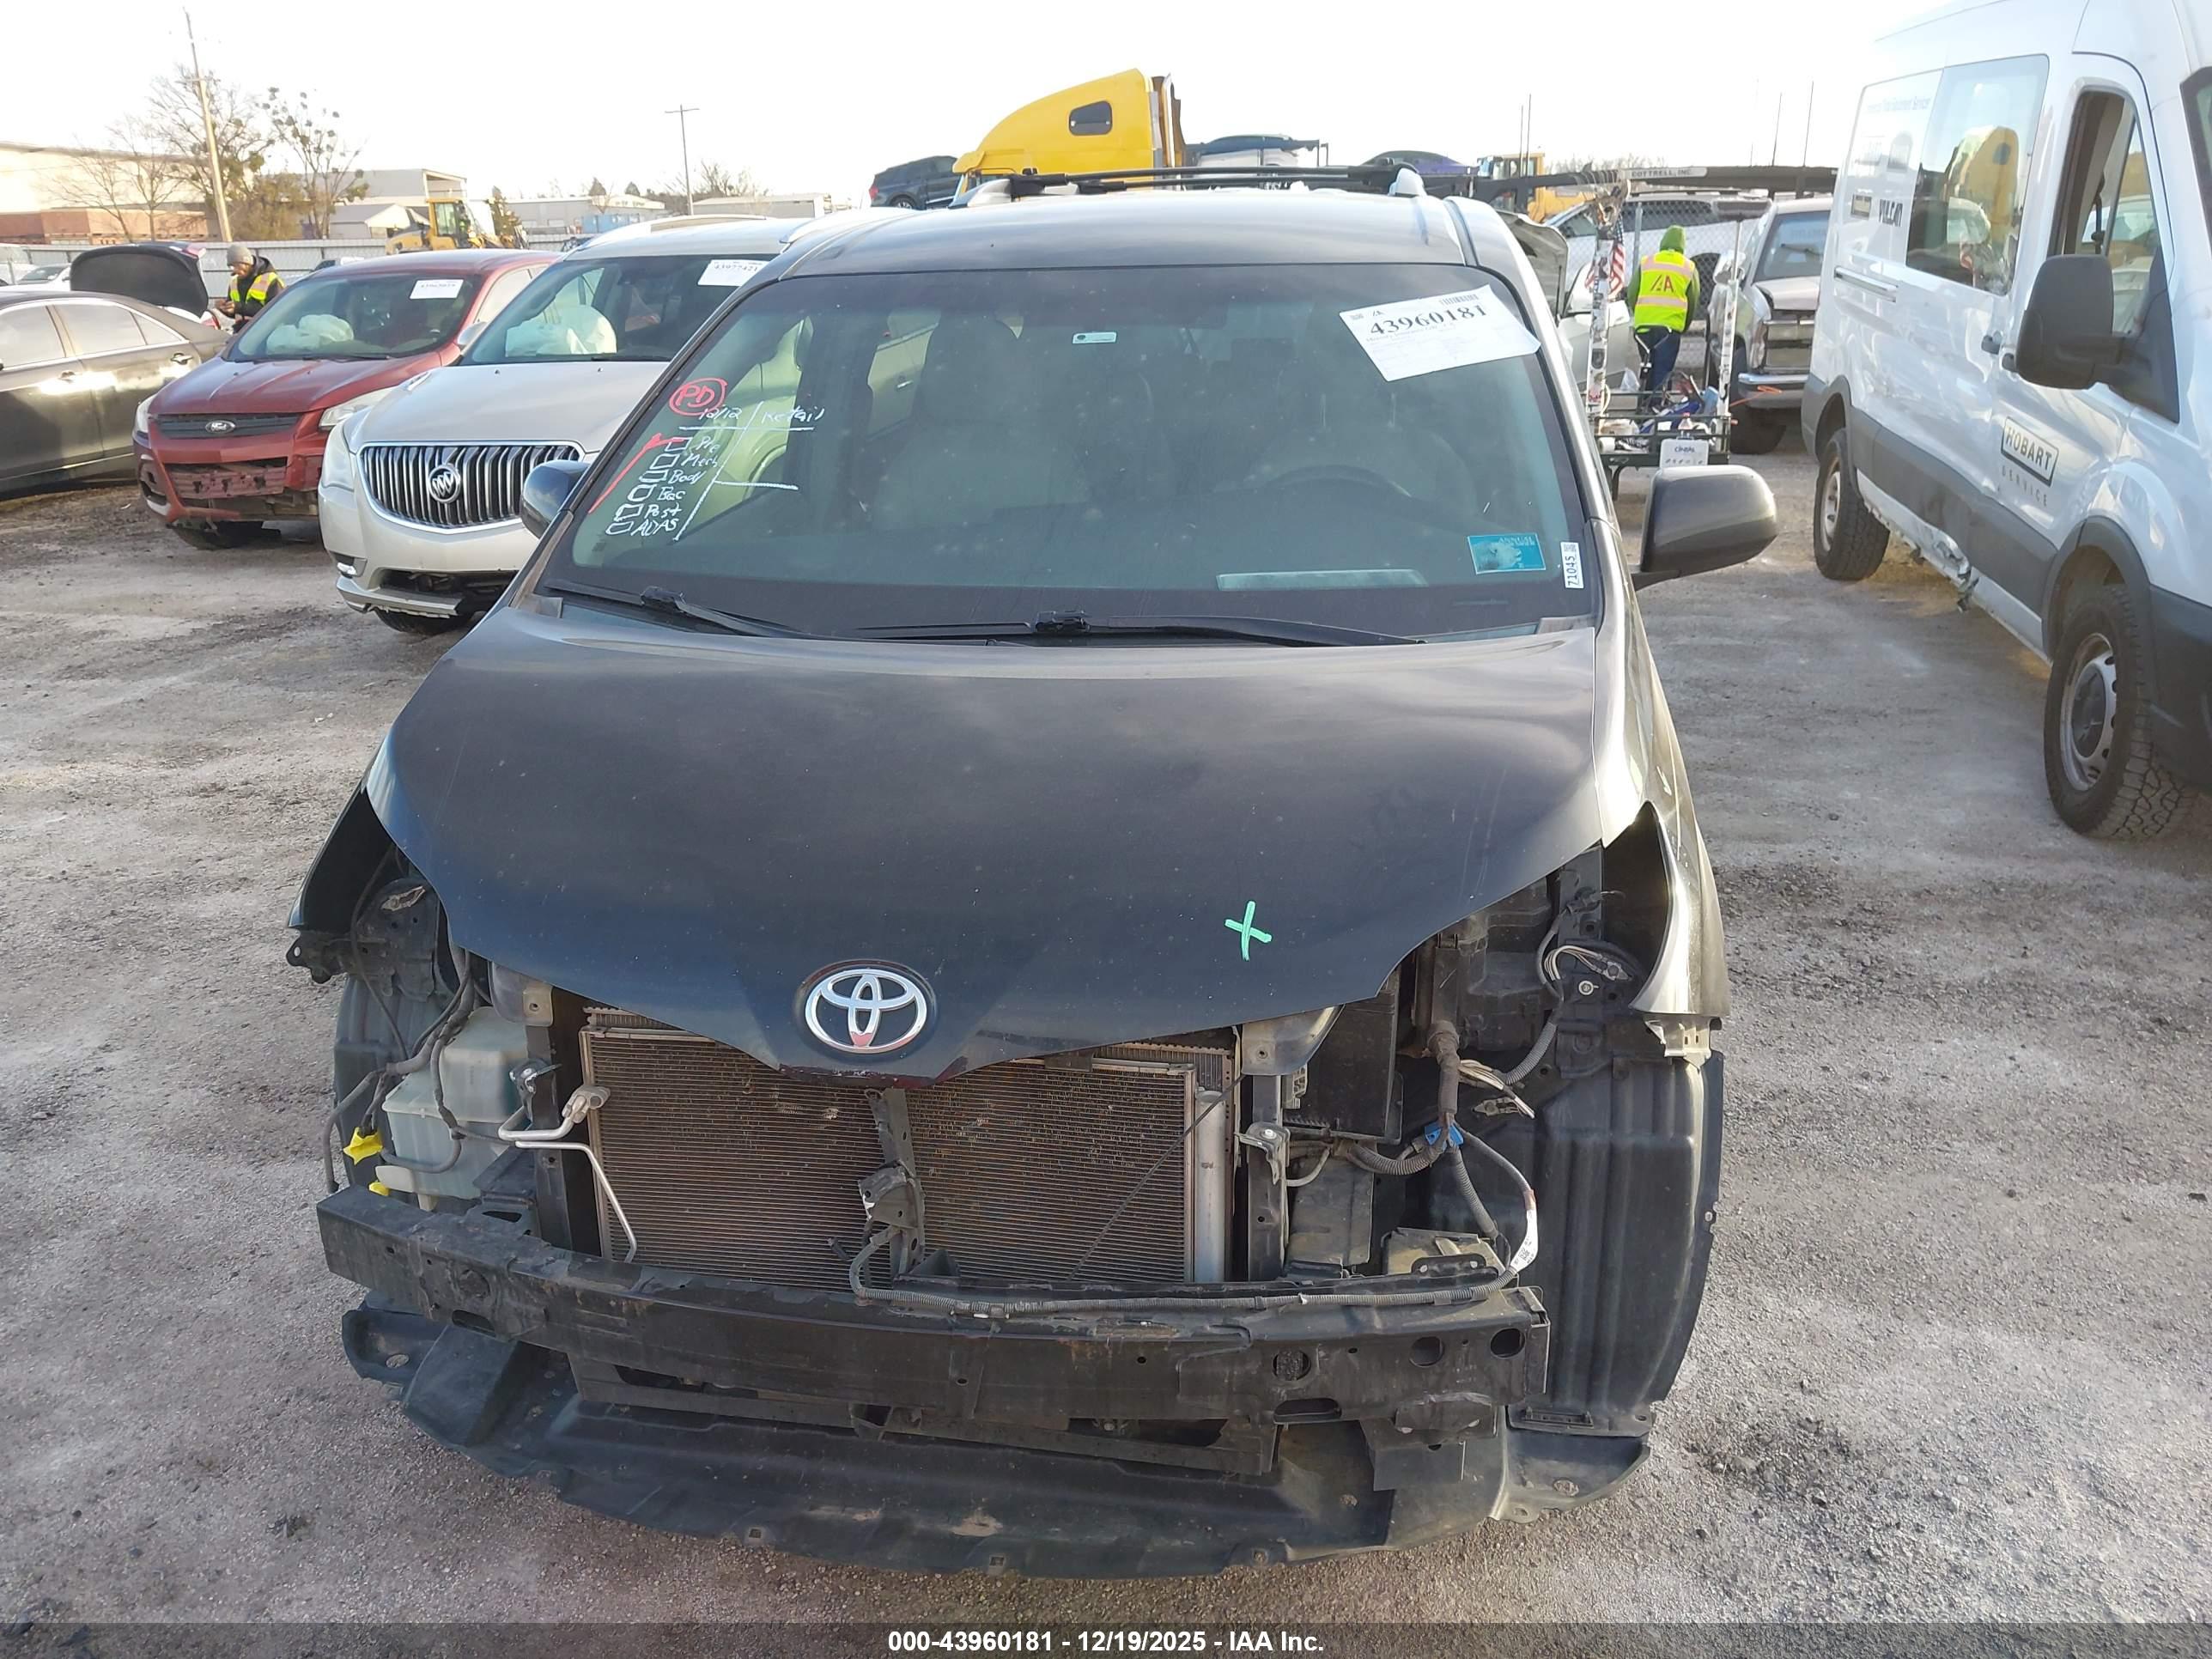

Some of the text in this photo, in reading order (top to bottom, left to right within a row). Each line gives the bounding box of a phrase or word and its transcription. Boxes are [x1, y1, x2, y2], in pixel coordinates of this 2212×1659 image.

[1370, 304, 1487, 335] 43960181
[696, 435, 720, 453] Pre
[2005, 428, 2052, 471] HOBART
[670, 470, 707, 484] Body
[2001, 465, 2048, 507] SERVICE
[645, 503, 682, 520] Post
[1565, 556, 1578, 586] 71045
